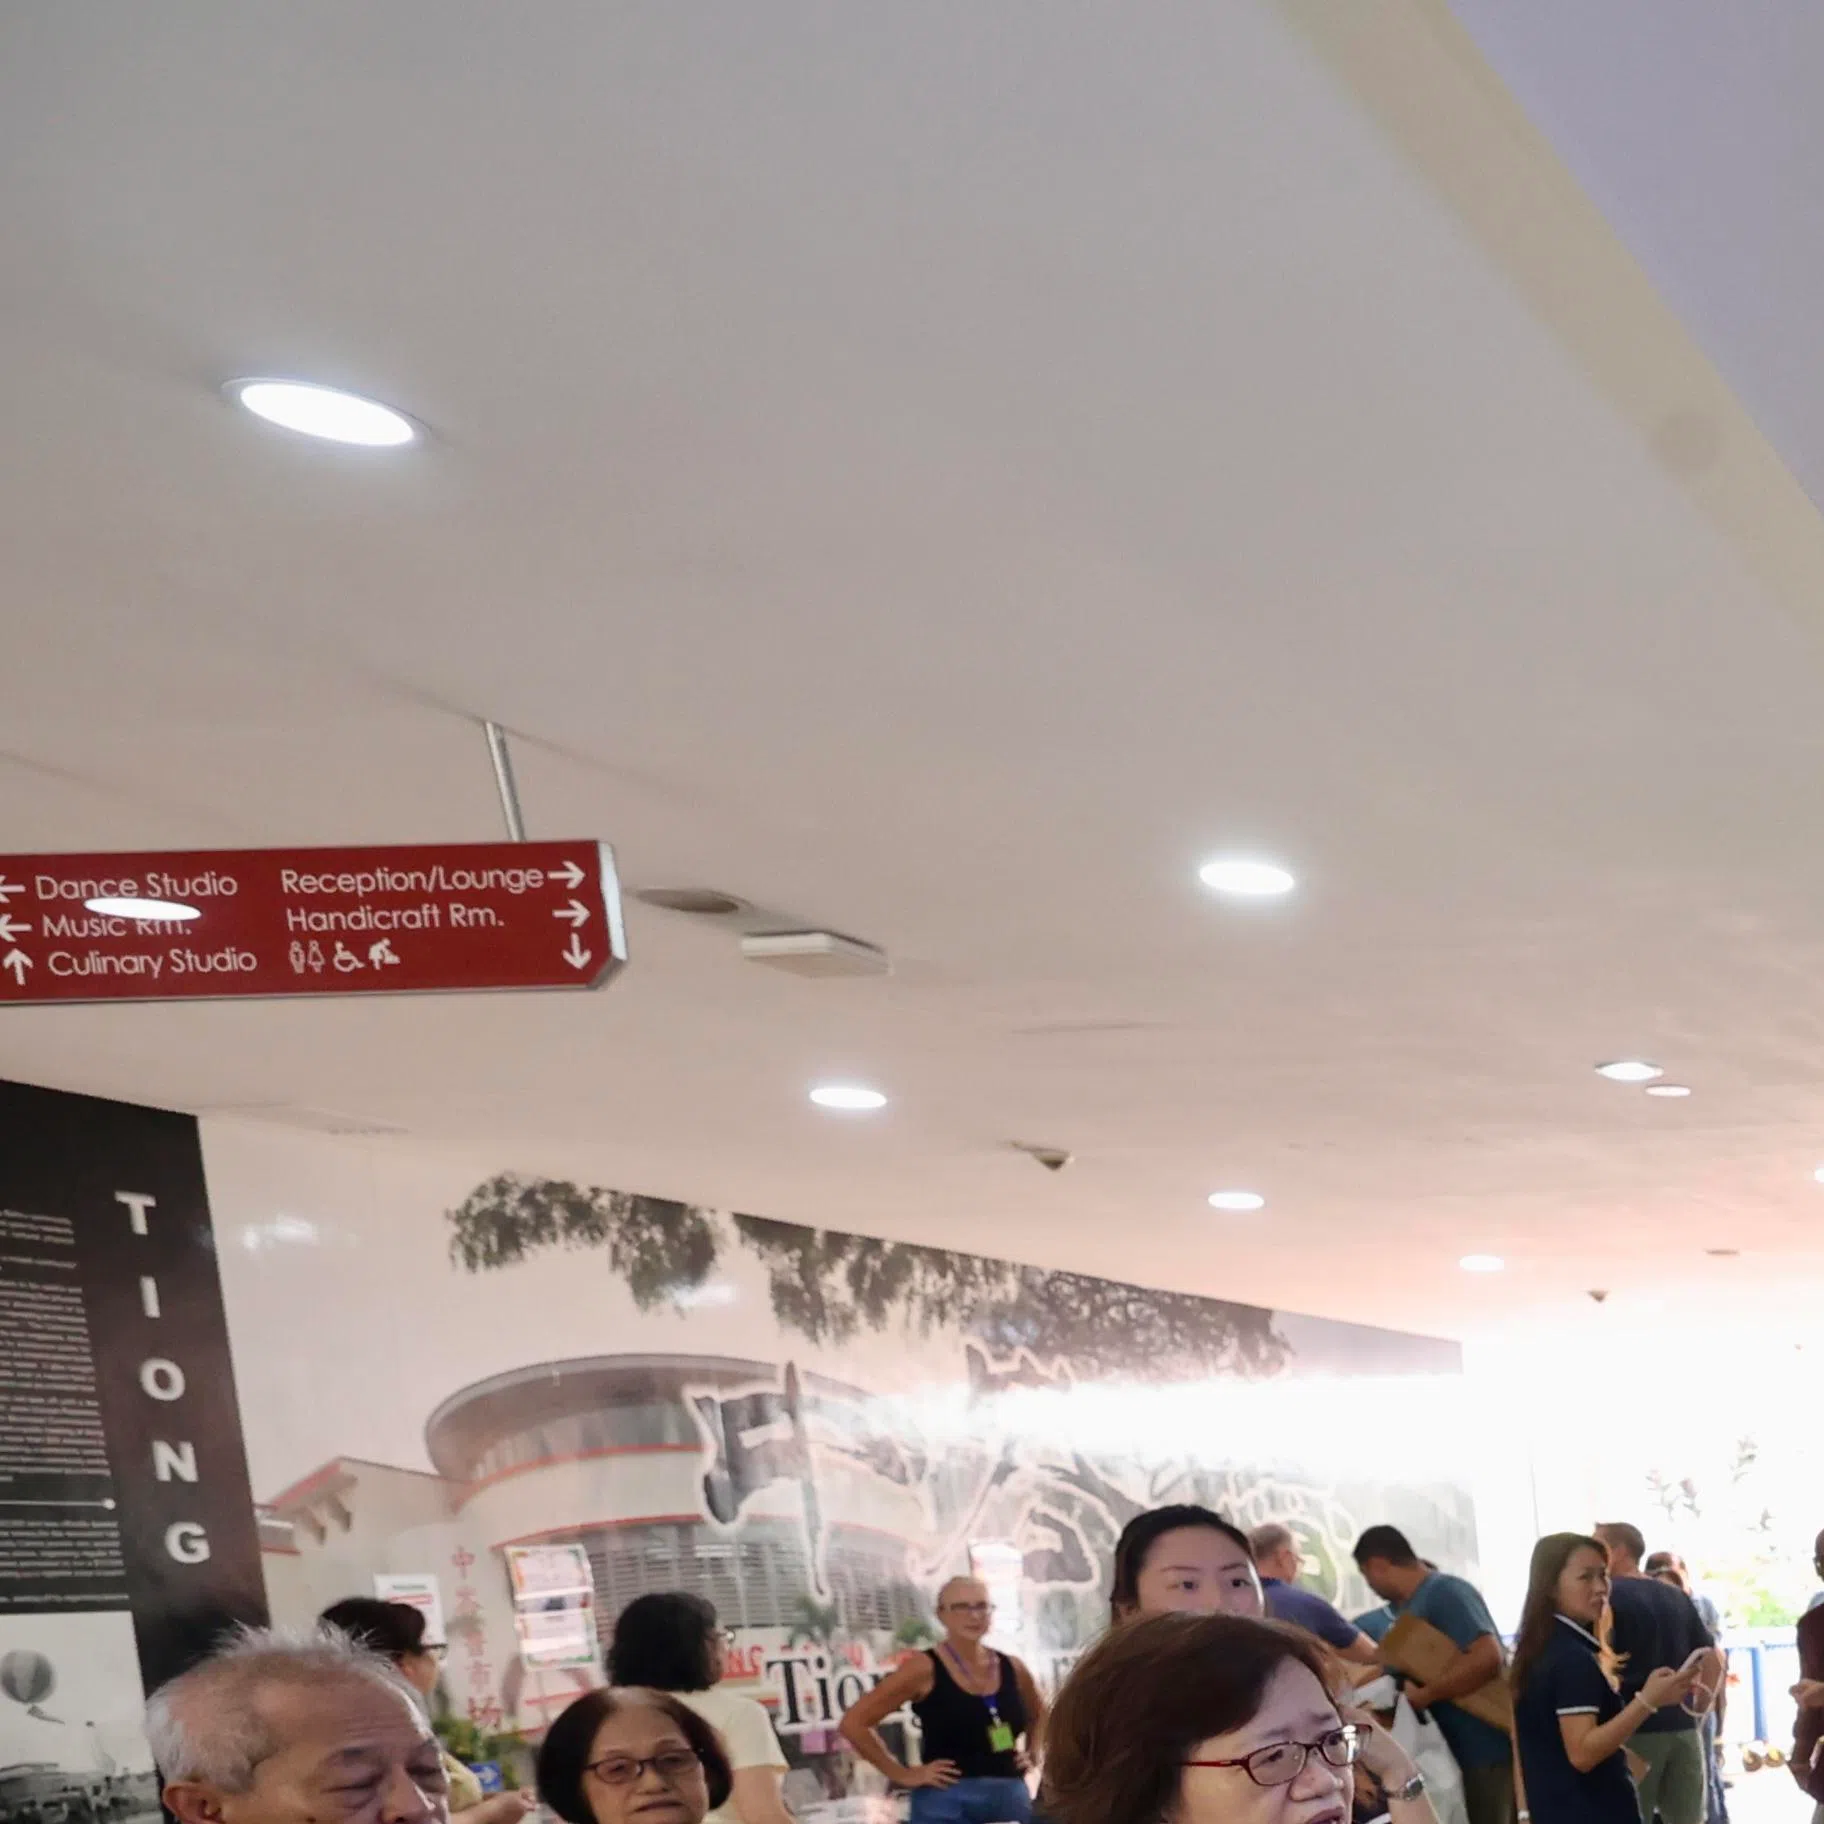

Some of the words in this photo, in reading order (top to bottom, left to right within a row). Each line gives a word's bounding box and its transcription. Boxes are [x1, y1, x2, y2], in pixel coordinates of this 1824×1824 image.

[35, 875, 138, 900] Dance
[147, 870, 239, 898] Studio
[281, 865, 545, 897] Reception/Lounge
[43, 912, 128, 939] Music
[286, 903, 441, 931] Handicraft
[449, 902, 505, 927] Rm.
[48, 951, 164, 979] Culinary
[171, 946, 258, 973] Studio
[115, 1190, 210, 1564] TIONG
[766, 1655, 895, 1725] Tio
